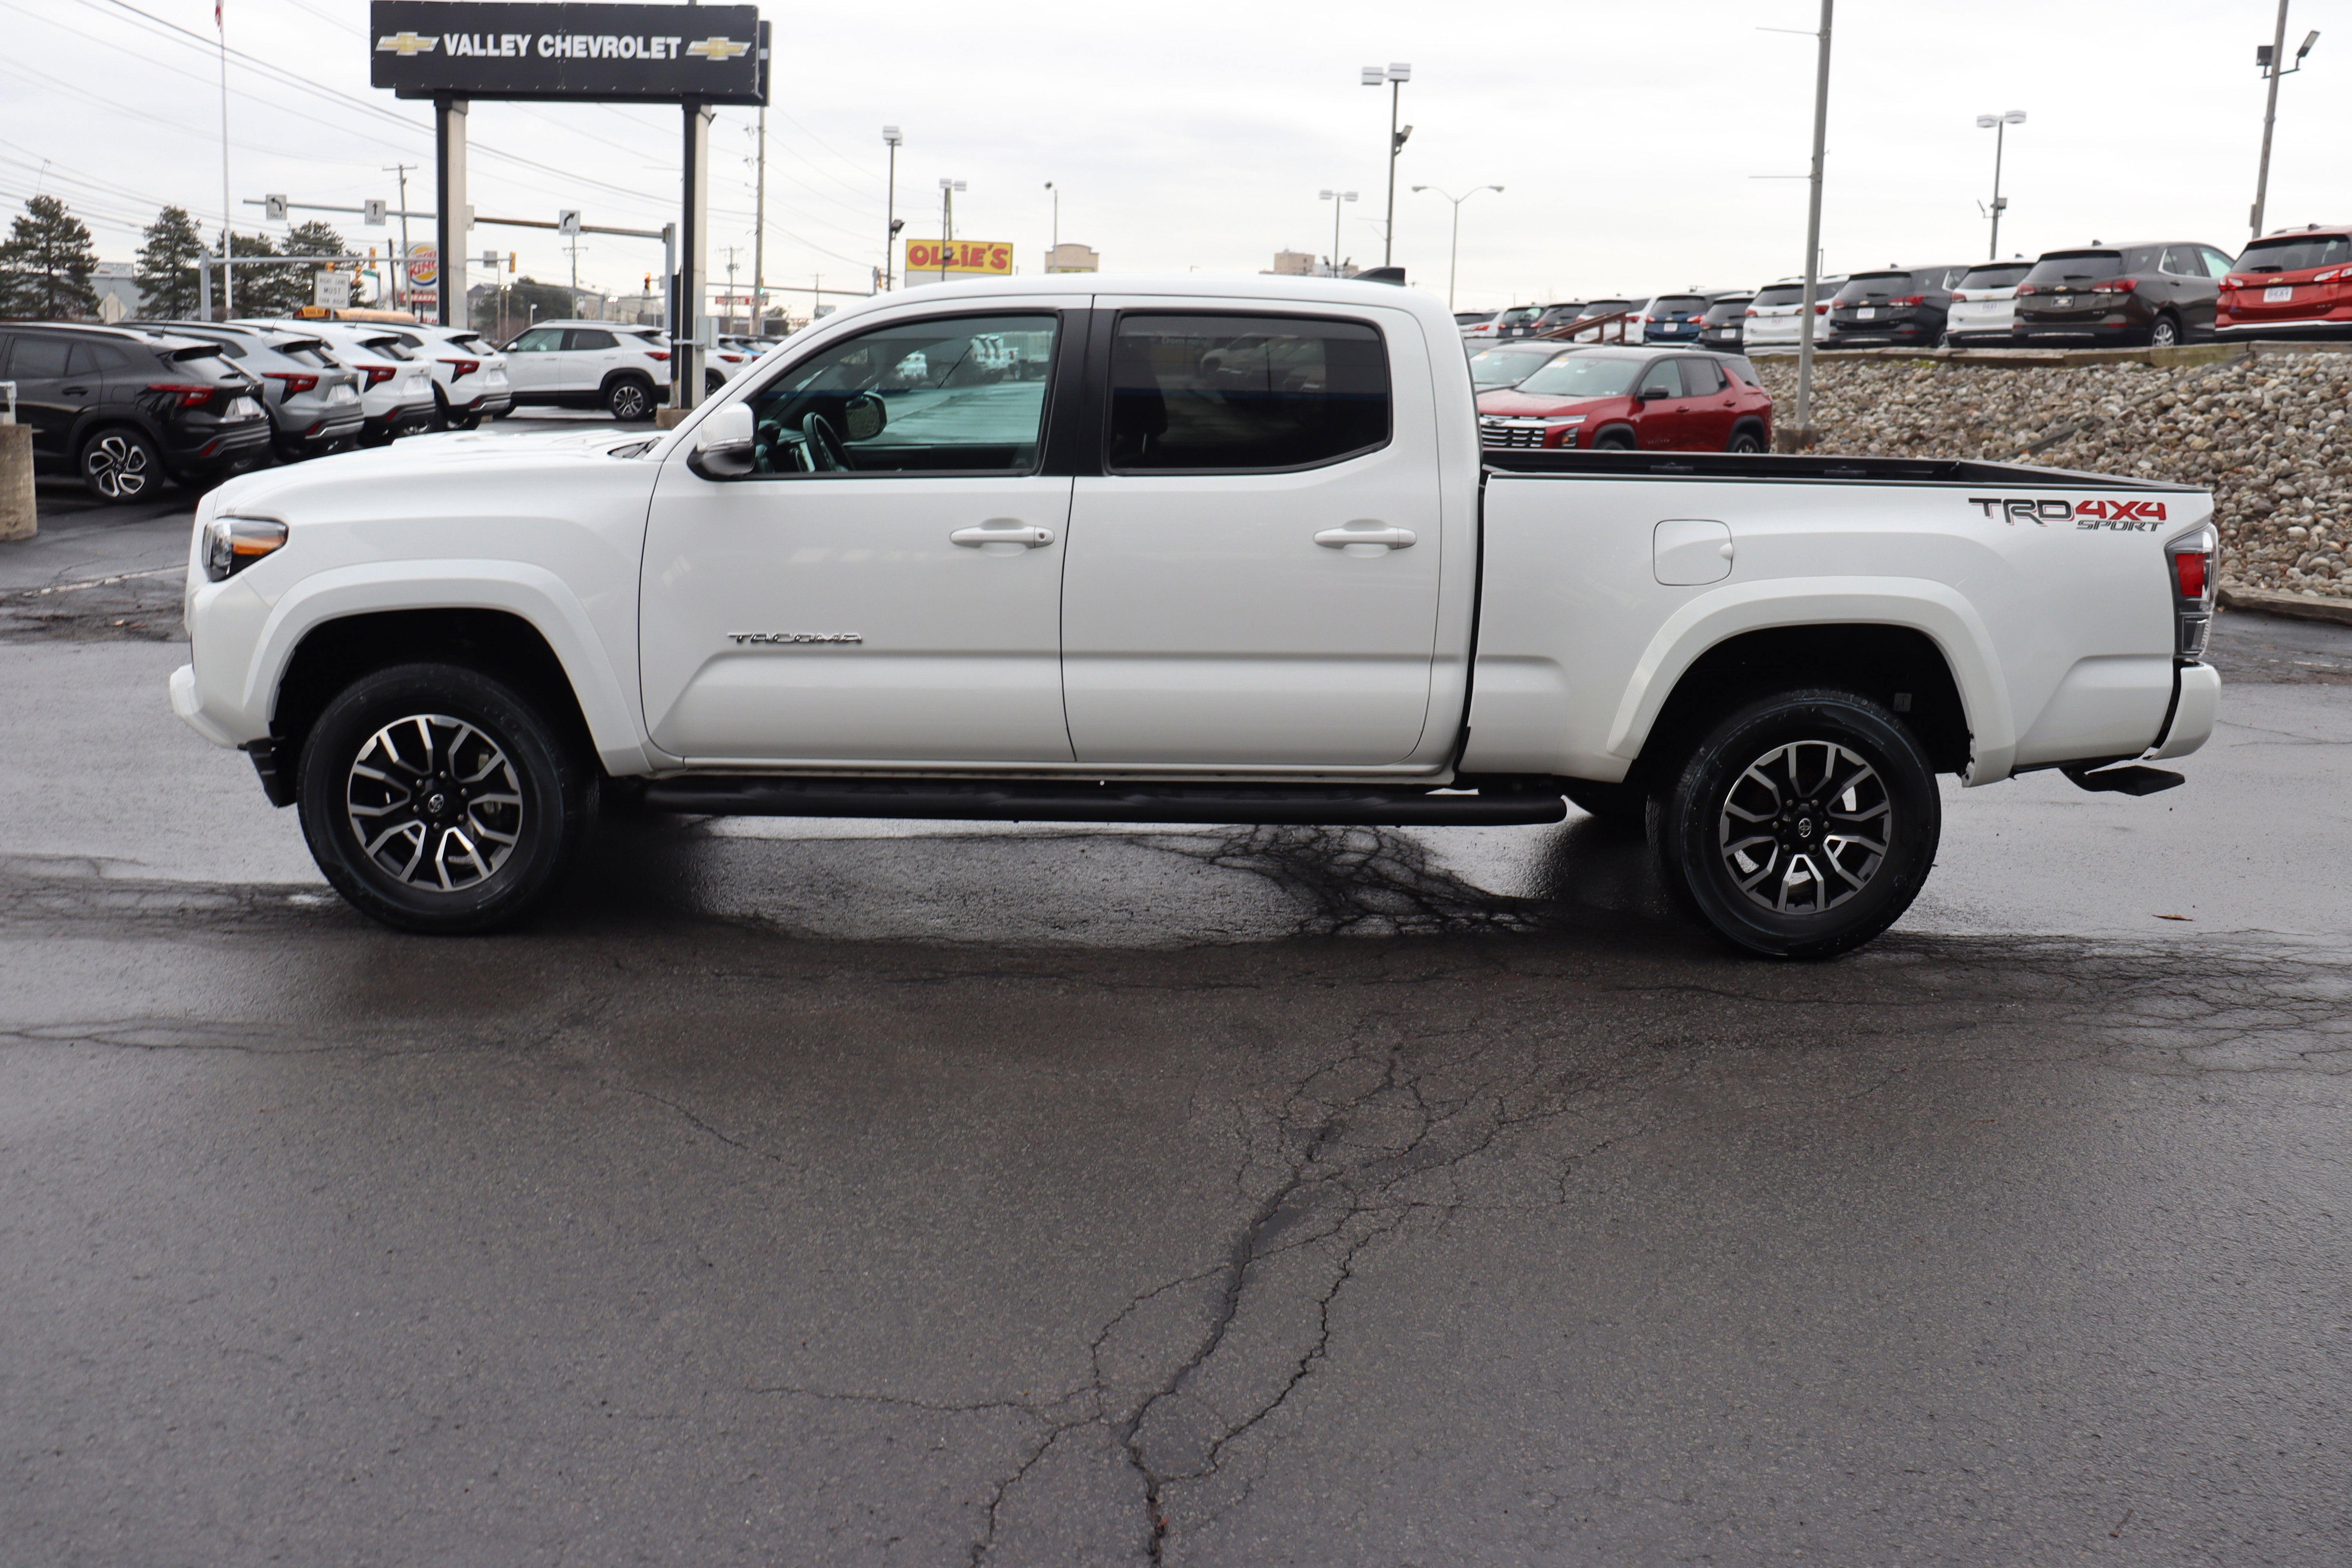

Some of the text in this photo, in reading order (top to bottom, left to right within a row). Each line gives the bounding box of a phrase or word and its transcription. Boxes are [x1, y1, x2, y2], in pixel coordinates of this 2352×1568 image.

[443, 33, 682, 59] VALLEY CHEVROLET
[323, 287, 341, 295] MUST
[1968, 498, 2075, 527] TRD
[2076, 520, 2164, 532] SPORT
[727, 632, 862, 644] TACOMA
